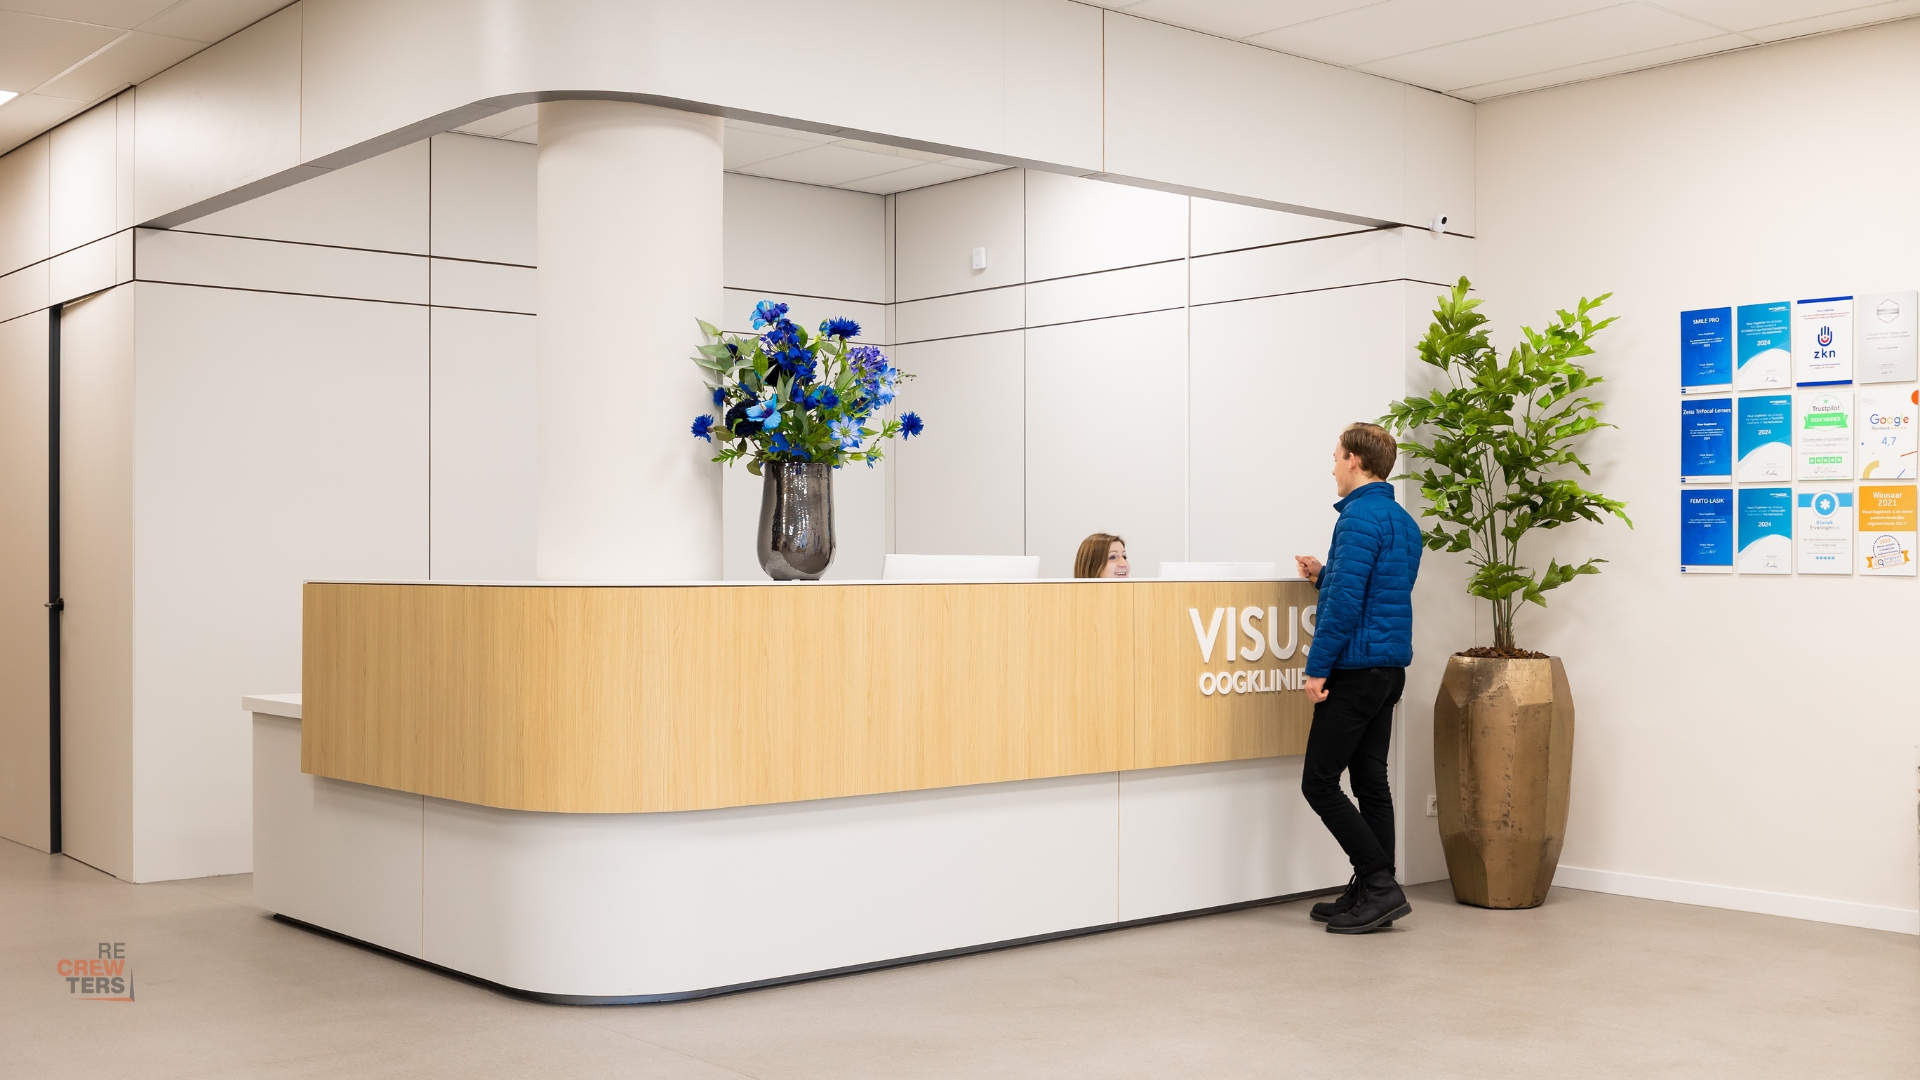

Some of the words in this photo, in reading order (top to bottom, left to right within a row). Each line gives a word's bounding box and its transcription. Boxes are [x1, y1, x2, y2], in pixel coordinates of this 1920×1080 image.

[1814, 348, 1835, 358] zkn
[1870, 414, 1909, 426] Google
[1881, 437, 1896, 446] 4,7
[1188, 606, 1318, 664] VISUS
[1200, 668, 1306, 696] OOGKLINIE
